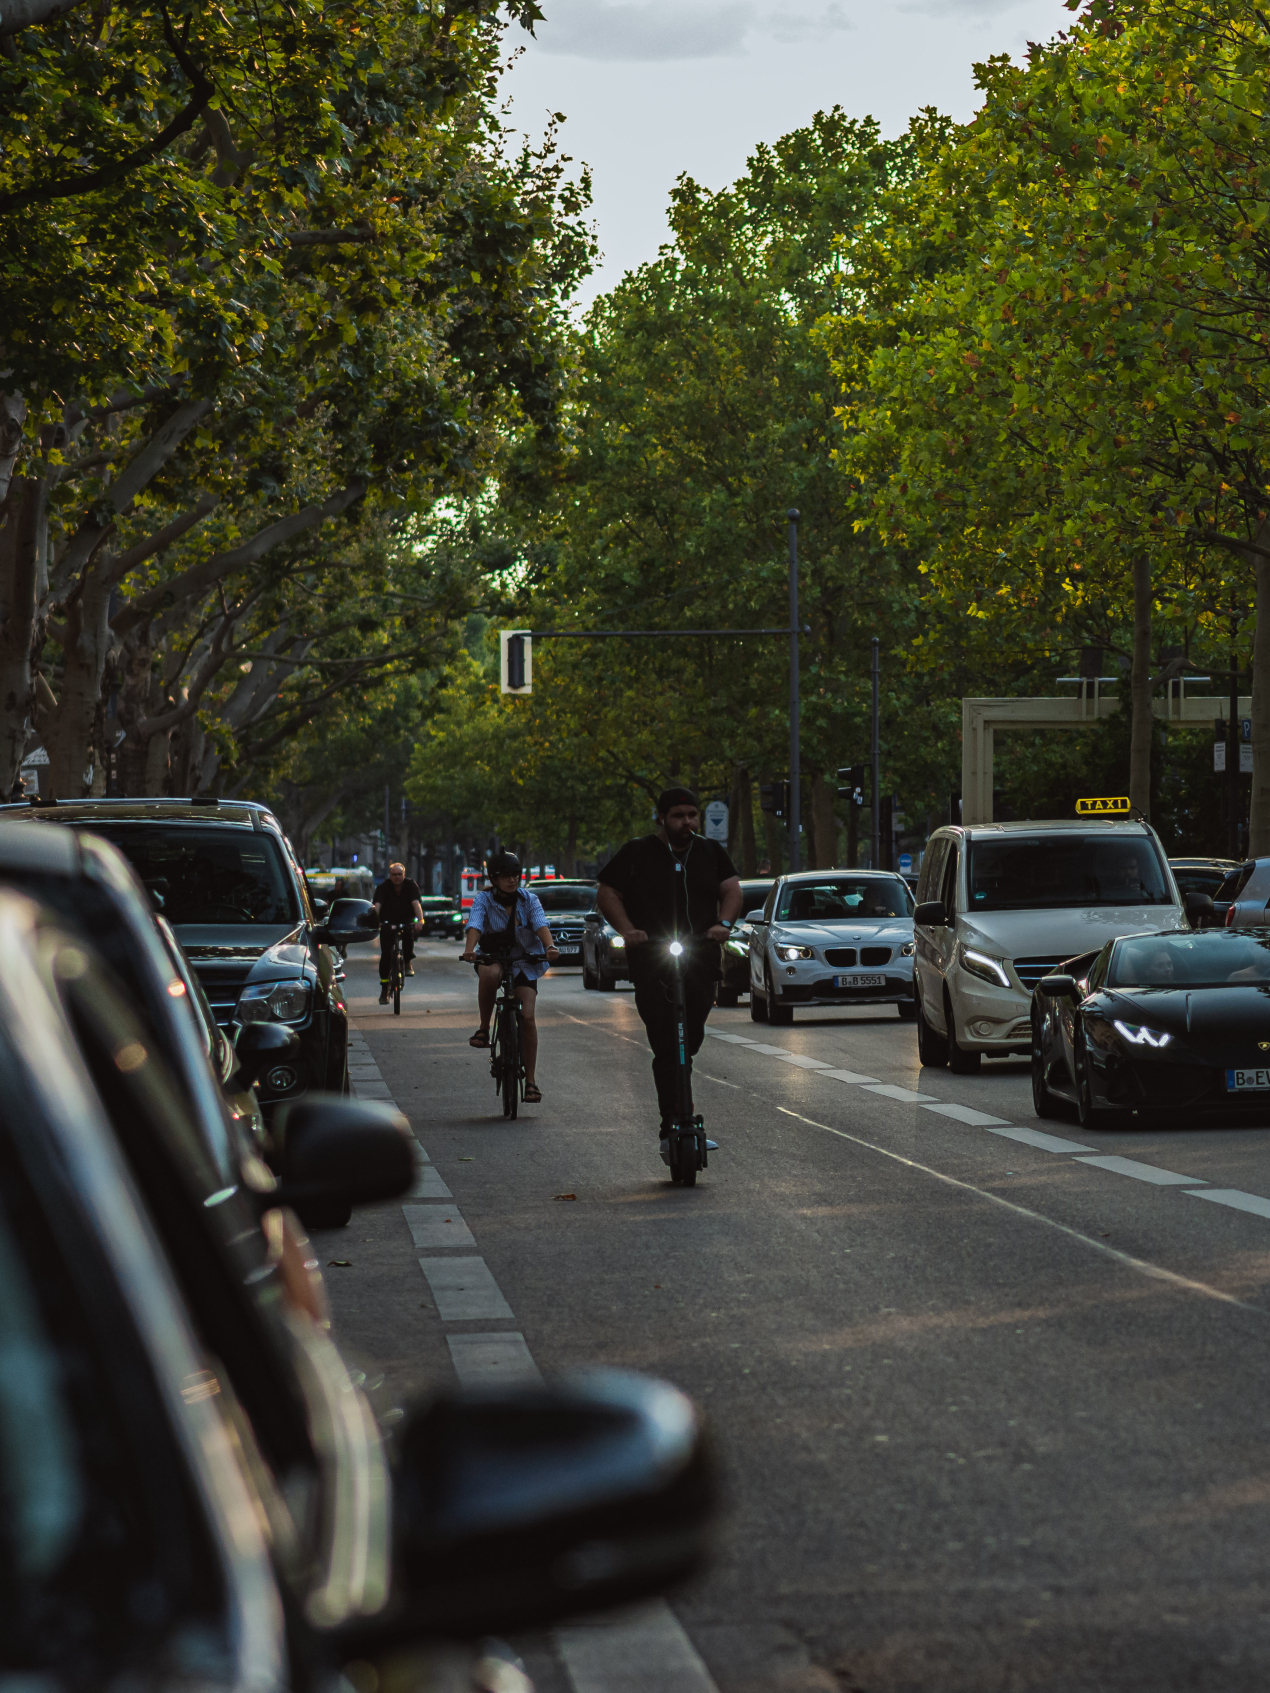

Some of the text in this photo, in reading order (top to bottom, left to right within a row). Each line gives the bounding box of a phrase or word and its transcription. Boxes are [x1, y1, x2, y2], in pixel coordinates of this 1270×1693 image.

[1243, 721, 1250, 737] P
[1085, 799, 1122, 810] TAXI
[841, 976, 882, 986] B B 5551
[1236, 1071, 1246, 1086] B
